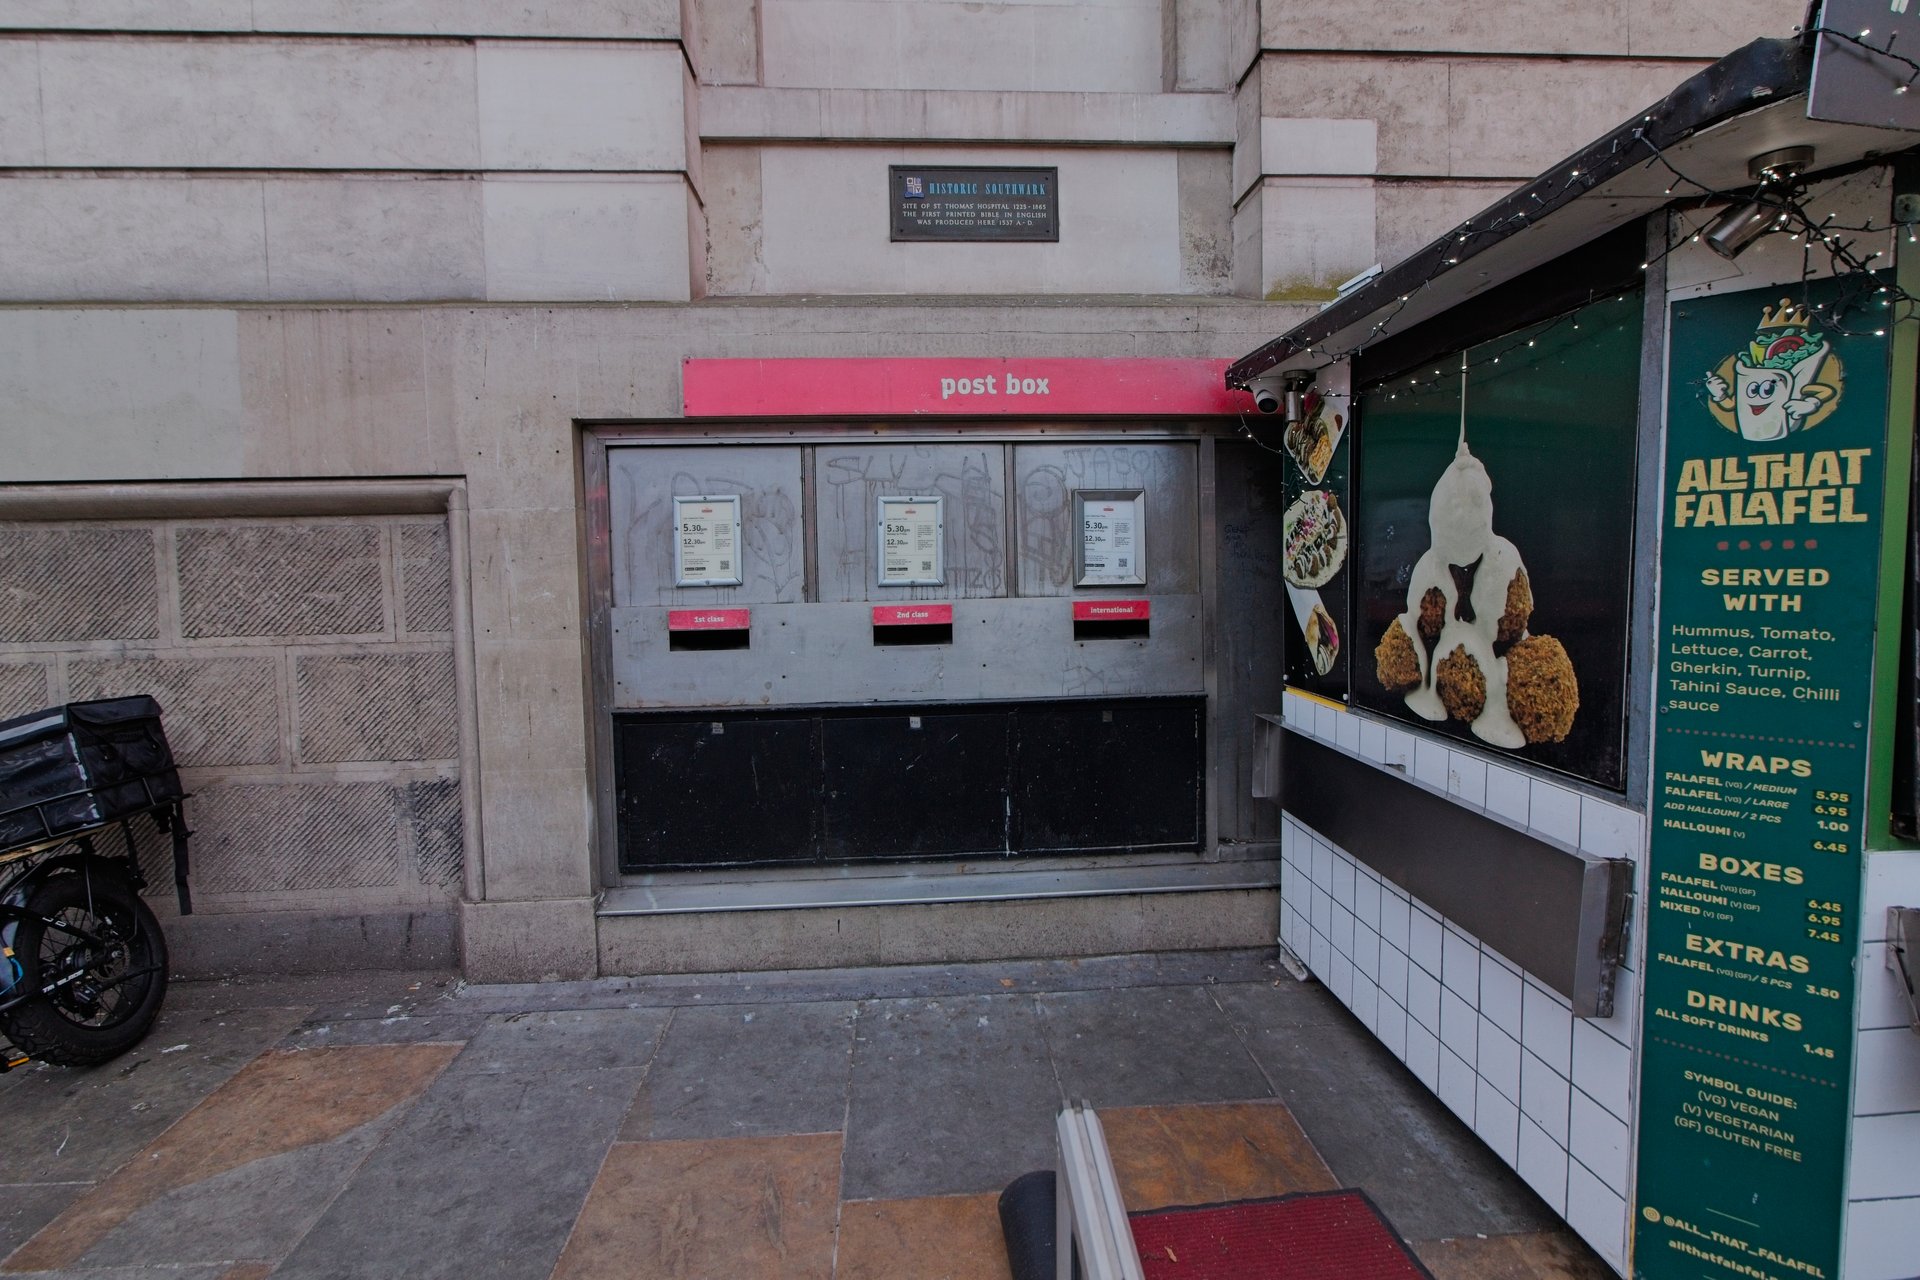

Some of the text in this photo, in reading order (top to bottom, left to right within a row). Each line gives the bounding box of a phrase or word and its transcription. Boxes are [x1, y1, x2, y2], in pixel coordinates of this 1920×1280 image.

[929, 183, 1045, 195] HISTORIC SOUTHWARK
[941, 373, 1049, 399] post box
[1677, 448, 1871, 493] ALL THAT
[1675, 488, 1868, 528] FALAFEL
[1701, 568, 1829, 586] SERVED
[1723, 594, 1802, 612] WITH
[1672, 625, 1836, 642] Hummus, Tomato,
[1672, 643, 1813, 661] Lettuce, Carrot,
[1670, 661, 1811, 681] Gherkin, Turnip,
[1669, 700, 1720, 712] sauce
[1670, 680, 1840, 701] Tahini Sauce, Chilli
[1701, 750, 1812, 778] WRAPS
[1665, 772, 1723, 787] FALAFEL
[1753, 783, 1797, 795] MEDIUM
[1815, 790, 1849, 803] 5.95
[1665, 787, 1722, 801] FALAFEL
[1753, 798, 1790, 810] LARGE
[1814, 805, 1848, 817] 6.95
[1664, 801, 1685, 811] ADD
[1686, 804, 1739, 818] HALLOUMI
[1759, 814, 1781, 824] PCS
[1817, 820, 1849, 832] 1.00
[1664, 819, 1731, 836] HALLOUMI
[1813, 841, 1847, 853] 6.45
[1699, 853, 1804, 885] BOXES
[1661, 872, 1718, 889] FALAFEL
[1808, 900, 1841, 911] 6.45
[1661, 886, 1727, 906] HALLOUMI
[1808, 913, 1841, 927] 6.95
[1660, 900, 1700, 915] MIXED
[1808, 929, 1841, 943] 7.45
[1686, 933, 1810, 974] EXTRAS
[1658, 953, 1714, 972] FALAFEL
[1770, 979, 1792, 989] PCS
[1806, 984, 1840, 999] 3.50
[1687, 990, 1802, 1032] DRINKS
[1655, 1008, 1834, 1059] ALL SOFT DRINKS 1.45
[1684, 1070, 1797, 1110] SYMBOL GUIDE:
[1698, 1091, 1780, 1122] (VG) VEGAN
[1683, 1103, 1795, 1143] (V) VEGETARIAN
[1674, 1116, 1802, 1162] (GF) GLUTEN FREE
